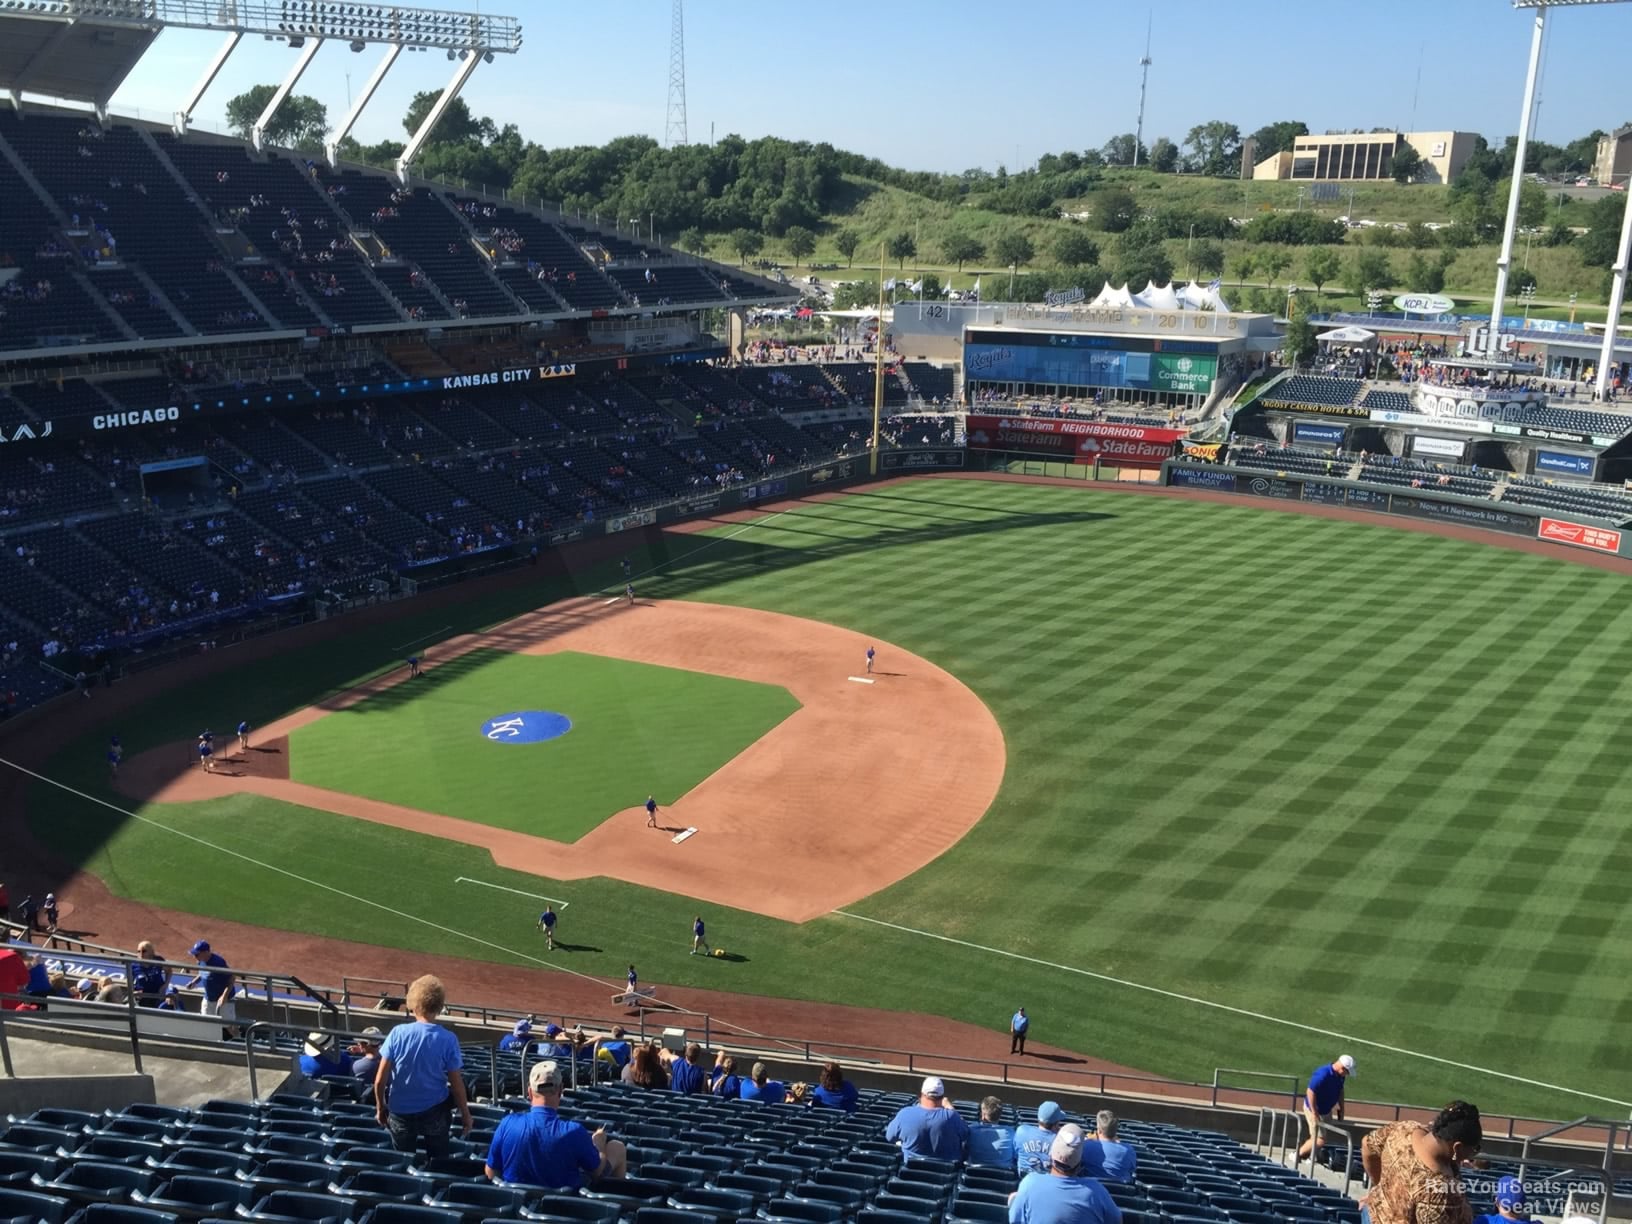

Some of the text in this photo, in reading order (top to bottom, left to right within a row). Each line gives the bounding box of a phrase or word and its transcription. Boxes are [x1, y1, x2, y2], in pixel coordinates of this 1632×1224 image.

[926, 305, 943, 318] 42
[1072, 308, 1122, 322] FAME
[1159, 315, 1177, 328] 20
[1193, 316, 1208, 329] 10
[1228, 317, 1238, 330] 5
[443, 369, 532, 389] KANSAS CITY
[1158, 370, 1209, 382] Commerce
[1171, 380, 1196, 391] Bank
[1261, 400, 1288, 409] RGOSY
[1290, 403, 1319, 411] CASINO
[1320, 406, 1345, 415] HOTEL
[1459, 401, 1477, 415] Lite
[1481, 404, 1500, 418] Lite
[93, 406, 180, 429] CHICAGO
[1060, 423, 1145, 438] NEIGHBORHOOD
[1527, 428, 1549, 438] Quality
[1550, 431, 1583, 442] Healthcare
[1184, 446, 1218, 457] SONIC
[1172, 468, 1236, 481] FAMILY FUNDAY
[1188, 477, 1221, 486] SUNDAY
[1420, 502, 1438, 511] Now,
[1451, 507, 1486, 518] Network
[1496, 514, 1508, 522] KC
[1583, 536, 1595, 544] FOR
[1584, 529, 1598, 538] THIS
[488, 717, 524, 739] KC
[1023, 1140, 1050, 1153] HOSM
